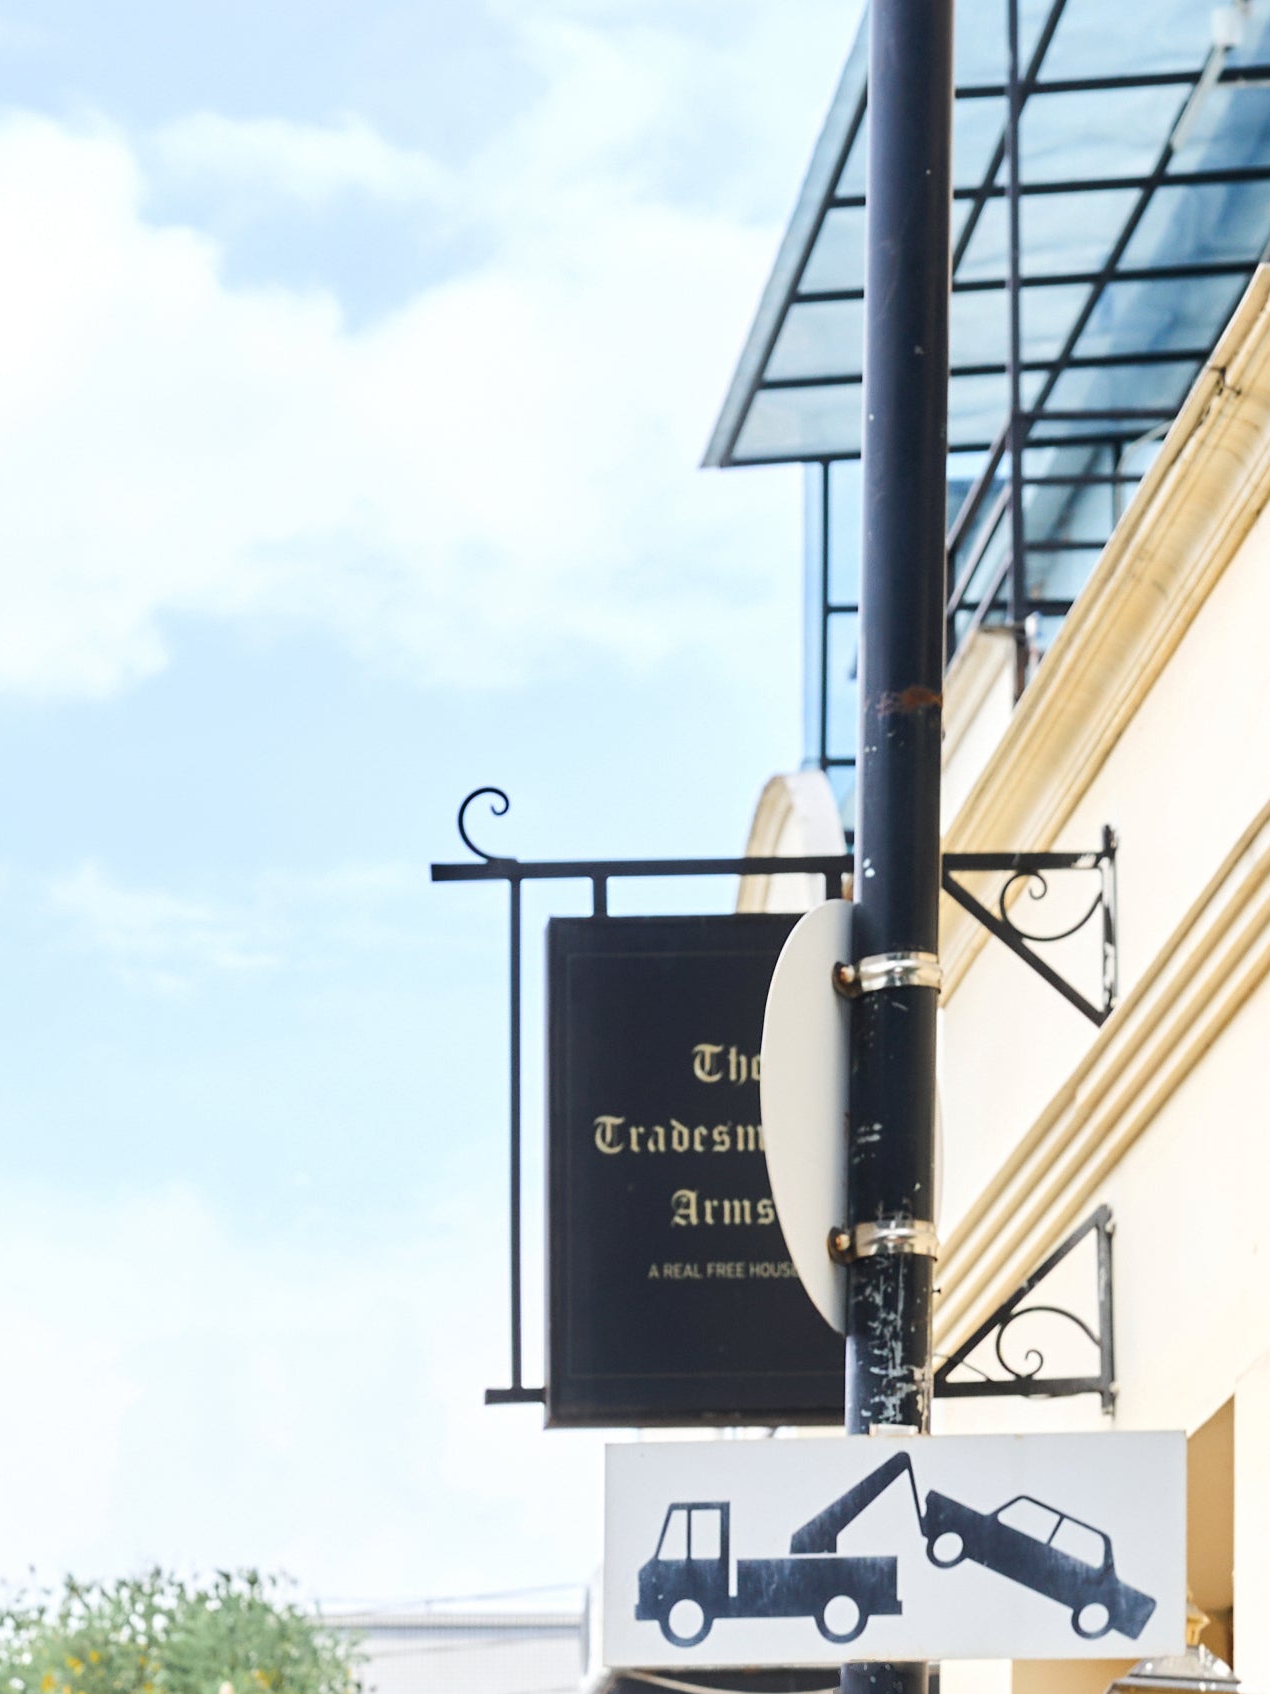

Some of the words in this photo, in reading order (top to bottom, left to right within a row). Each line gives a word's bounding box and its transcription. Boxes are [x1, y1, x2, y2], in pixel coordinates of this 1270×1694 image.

[593, 1115, 766, 1154] Tradesm
[671, 1189, 776, 1227] Arms
[647, 1262, 660, 1279] A
[663, 1262, 703, 1279] REAL
[706, 1260, 746, 1279] FREE
